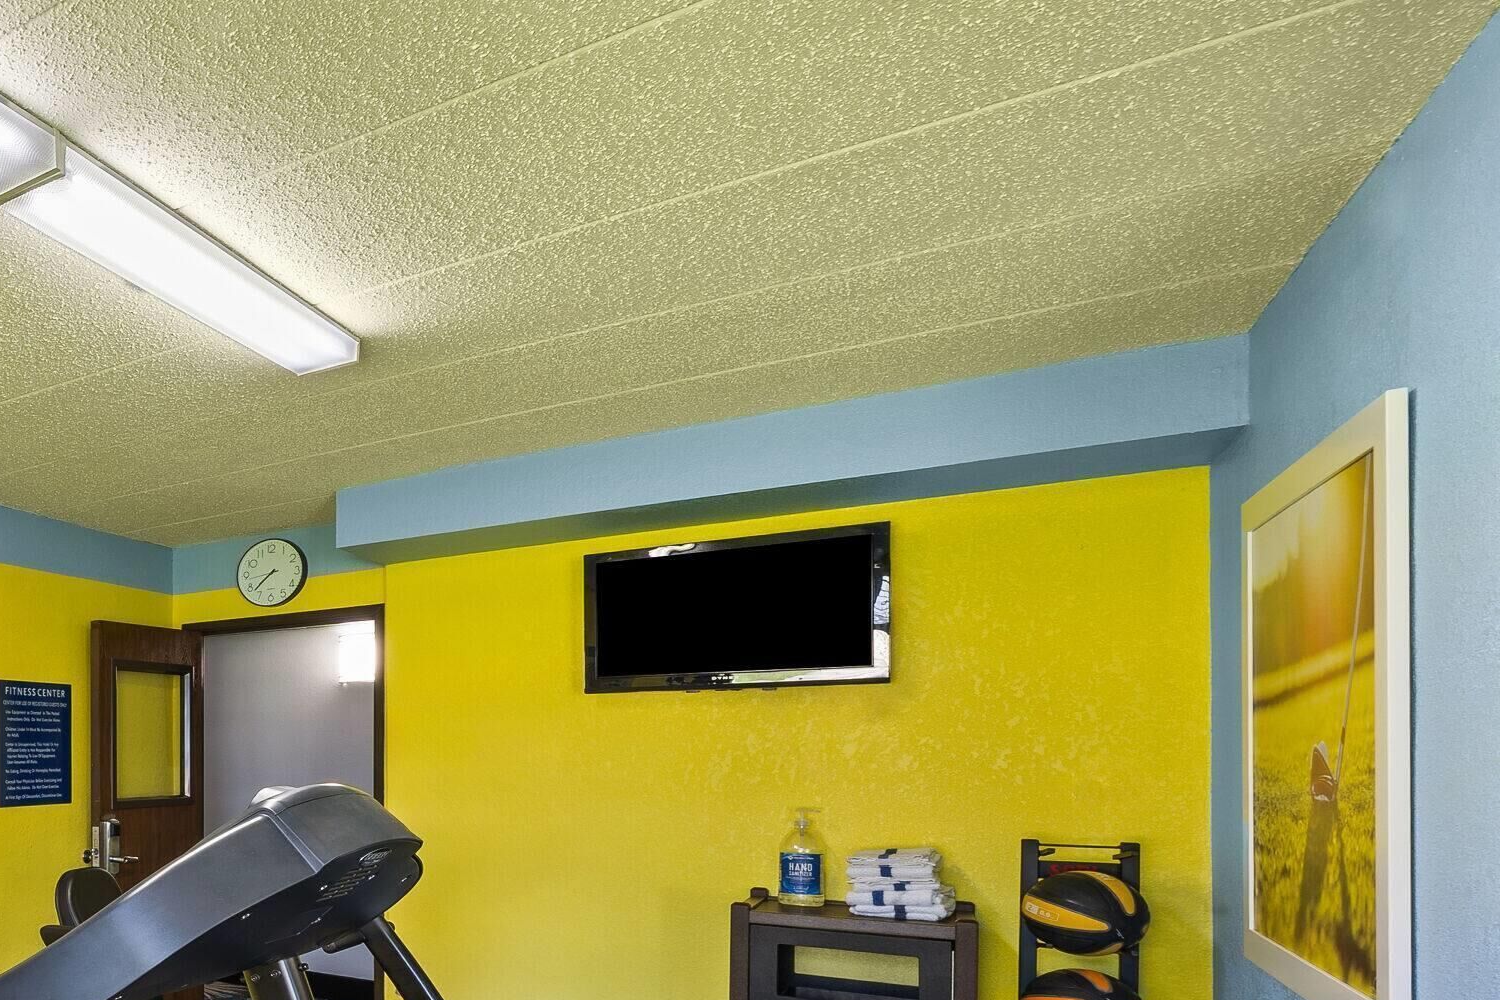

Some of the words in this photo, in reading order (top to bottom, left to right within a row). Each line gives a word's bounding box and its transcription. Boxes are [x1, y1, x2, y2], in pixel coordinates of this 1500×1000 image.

[289, 554, 297, 563] 2
[294, 566, 301, 575] 3
[4, 686, 36, 697] FITNESS
[37, 688, 66, 698] CENTER
[788, 862, 813, 872] HAND
